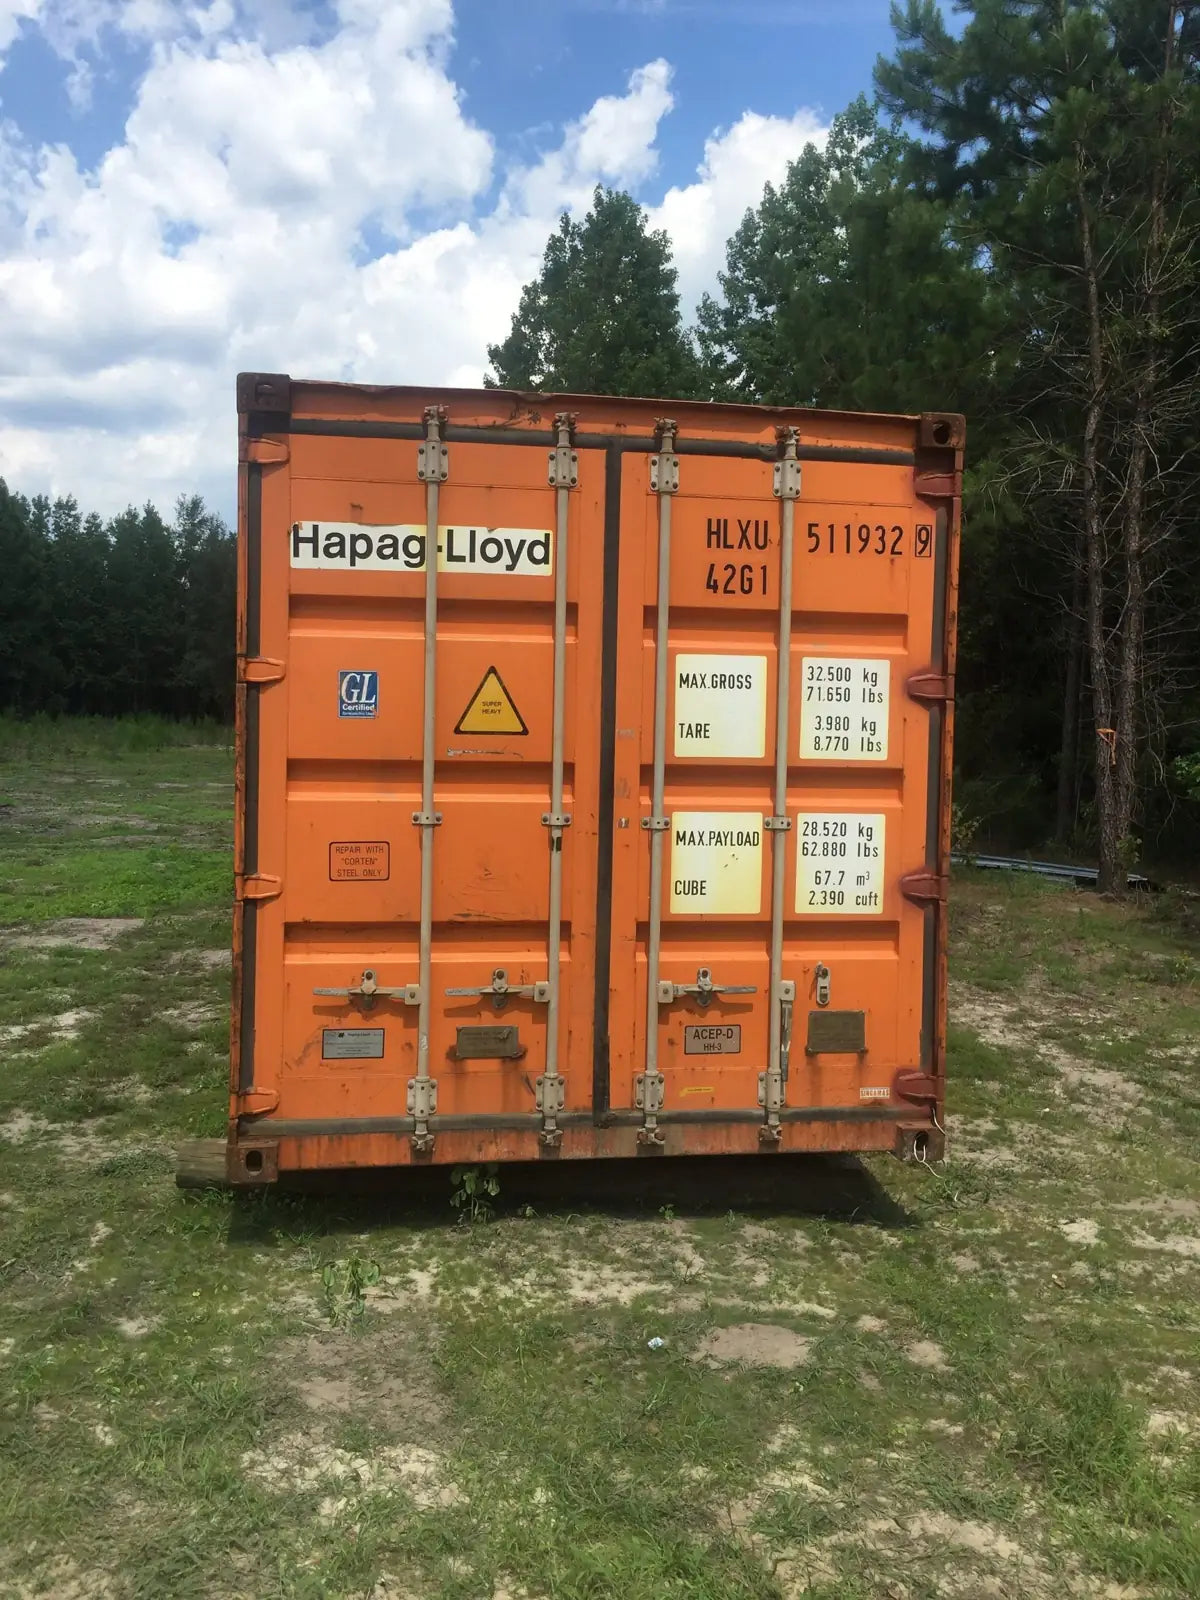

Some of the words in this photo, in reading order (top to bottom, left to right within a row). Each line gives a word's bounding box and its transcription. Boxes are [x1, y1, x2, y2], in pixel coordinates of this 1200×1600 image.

[707, 518, 769, 550] HLXU
[807, 523, 904, 556] 511932
[917, 526, 931, 556] 9
[292, 524, 551, 572] Hapag-Lloyd
[706, 563, 767, 595] 42G1
[679, 673, 752, 689] MAX.GROSS
[863, 668, 878, 686] kg
[341, 673, 376, 703] GL
[862, 688, 884, 703] lbs
[342, 703, 375, 711] Certified
[679, 723, 711, 739] TARE
[861, 717, 877, 736] kg
[860, 737, 882, 752] lbs
[675, 830, 760, 847] MAX.PAYLOAD
[802, 821, 847, 837] 28.520
[858, 823, 873, 841] kg
[335, 846, 361, 854] REPAIR
[366, 846, 384, 854] WITH
[801, 842, 846, 857] 62.880
[857, 843, 879, 858] lbs
[336, 869, 359, 877] STEEL
[362, 869, 382, 877] ONLY
[814, 871, 845, 886] 67.7
[674, 880, 707, 896] CUBE
[808, 891, 845, 906] 2.390
[855, 893, 878, 906] cuft
[693, 1028, 733, 1040] ACEP-D
[703, 1043, 722, 1051] HH-3
